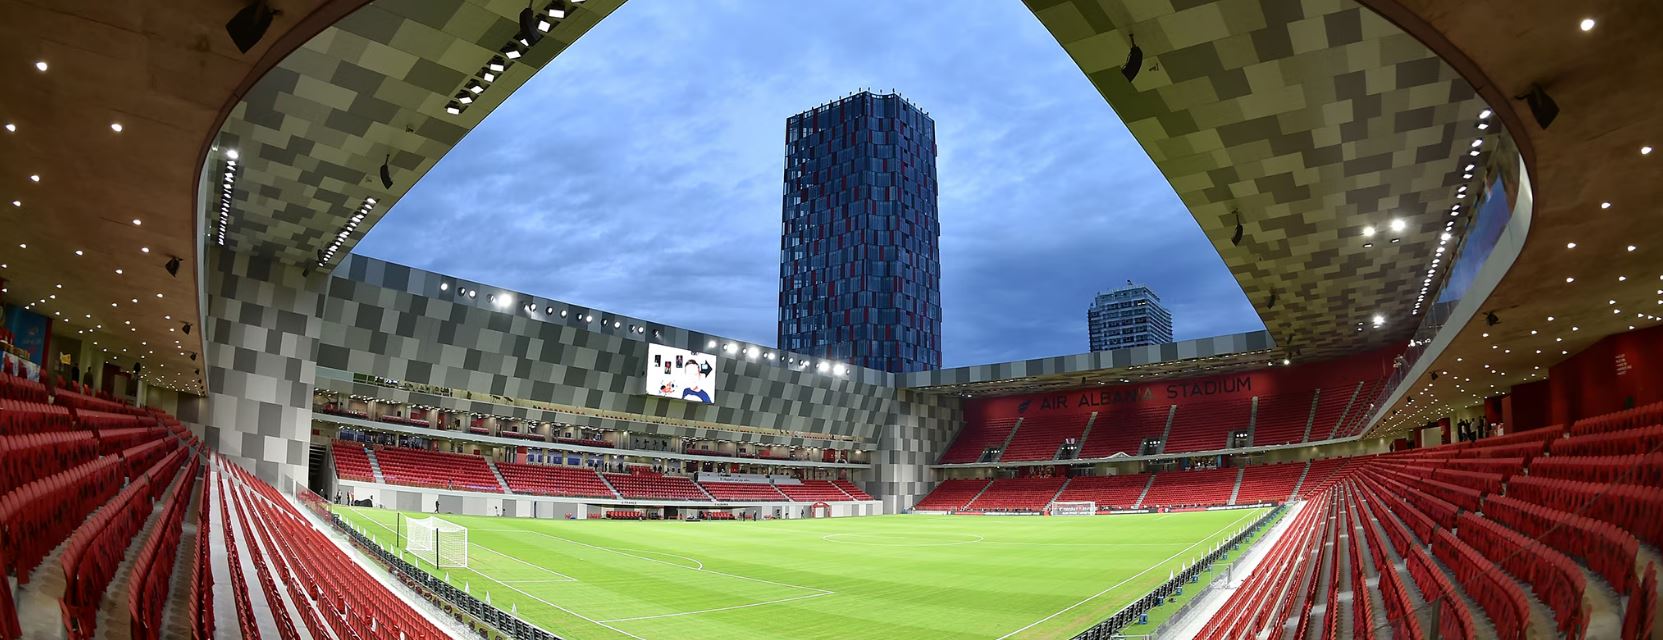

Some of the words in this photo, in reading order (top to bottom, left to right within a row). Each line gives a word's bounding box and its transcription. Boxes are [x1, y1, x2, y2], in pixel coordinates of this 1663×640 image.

[1040, 395, 1068, 410] AIR
[1078, 387, 1153, 407] ALBANIA
[1166, 377, 1252, 399] STADIUM
